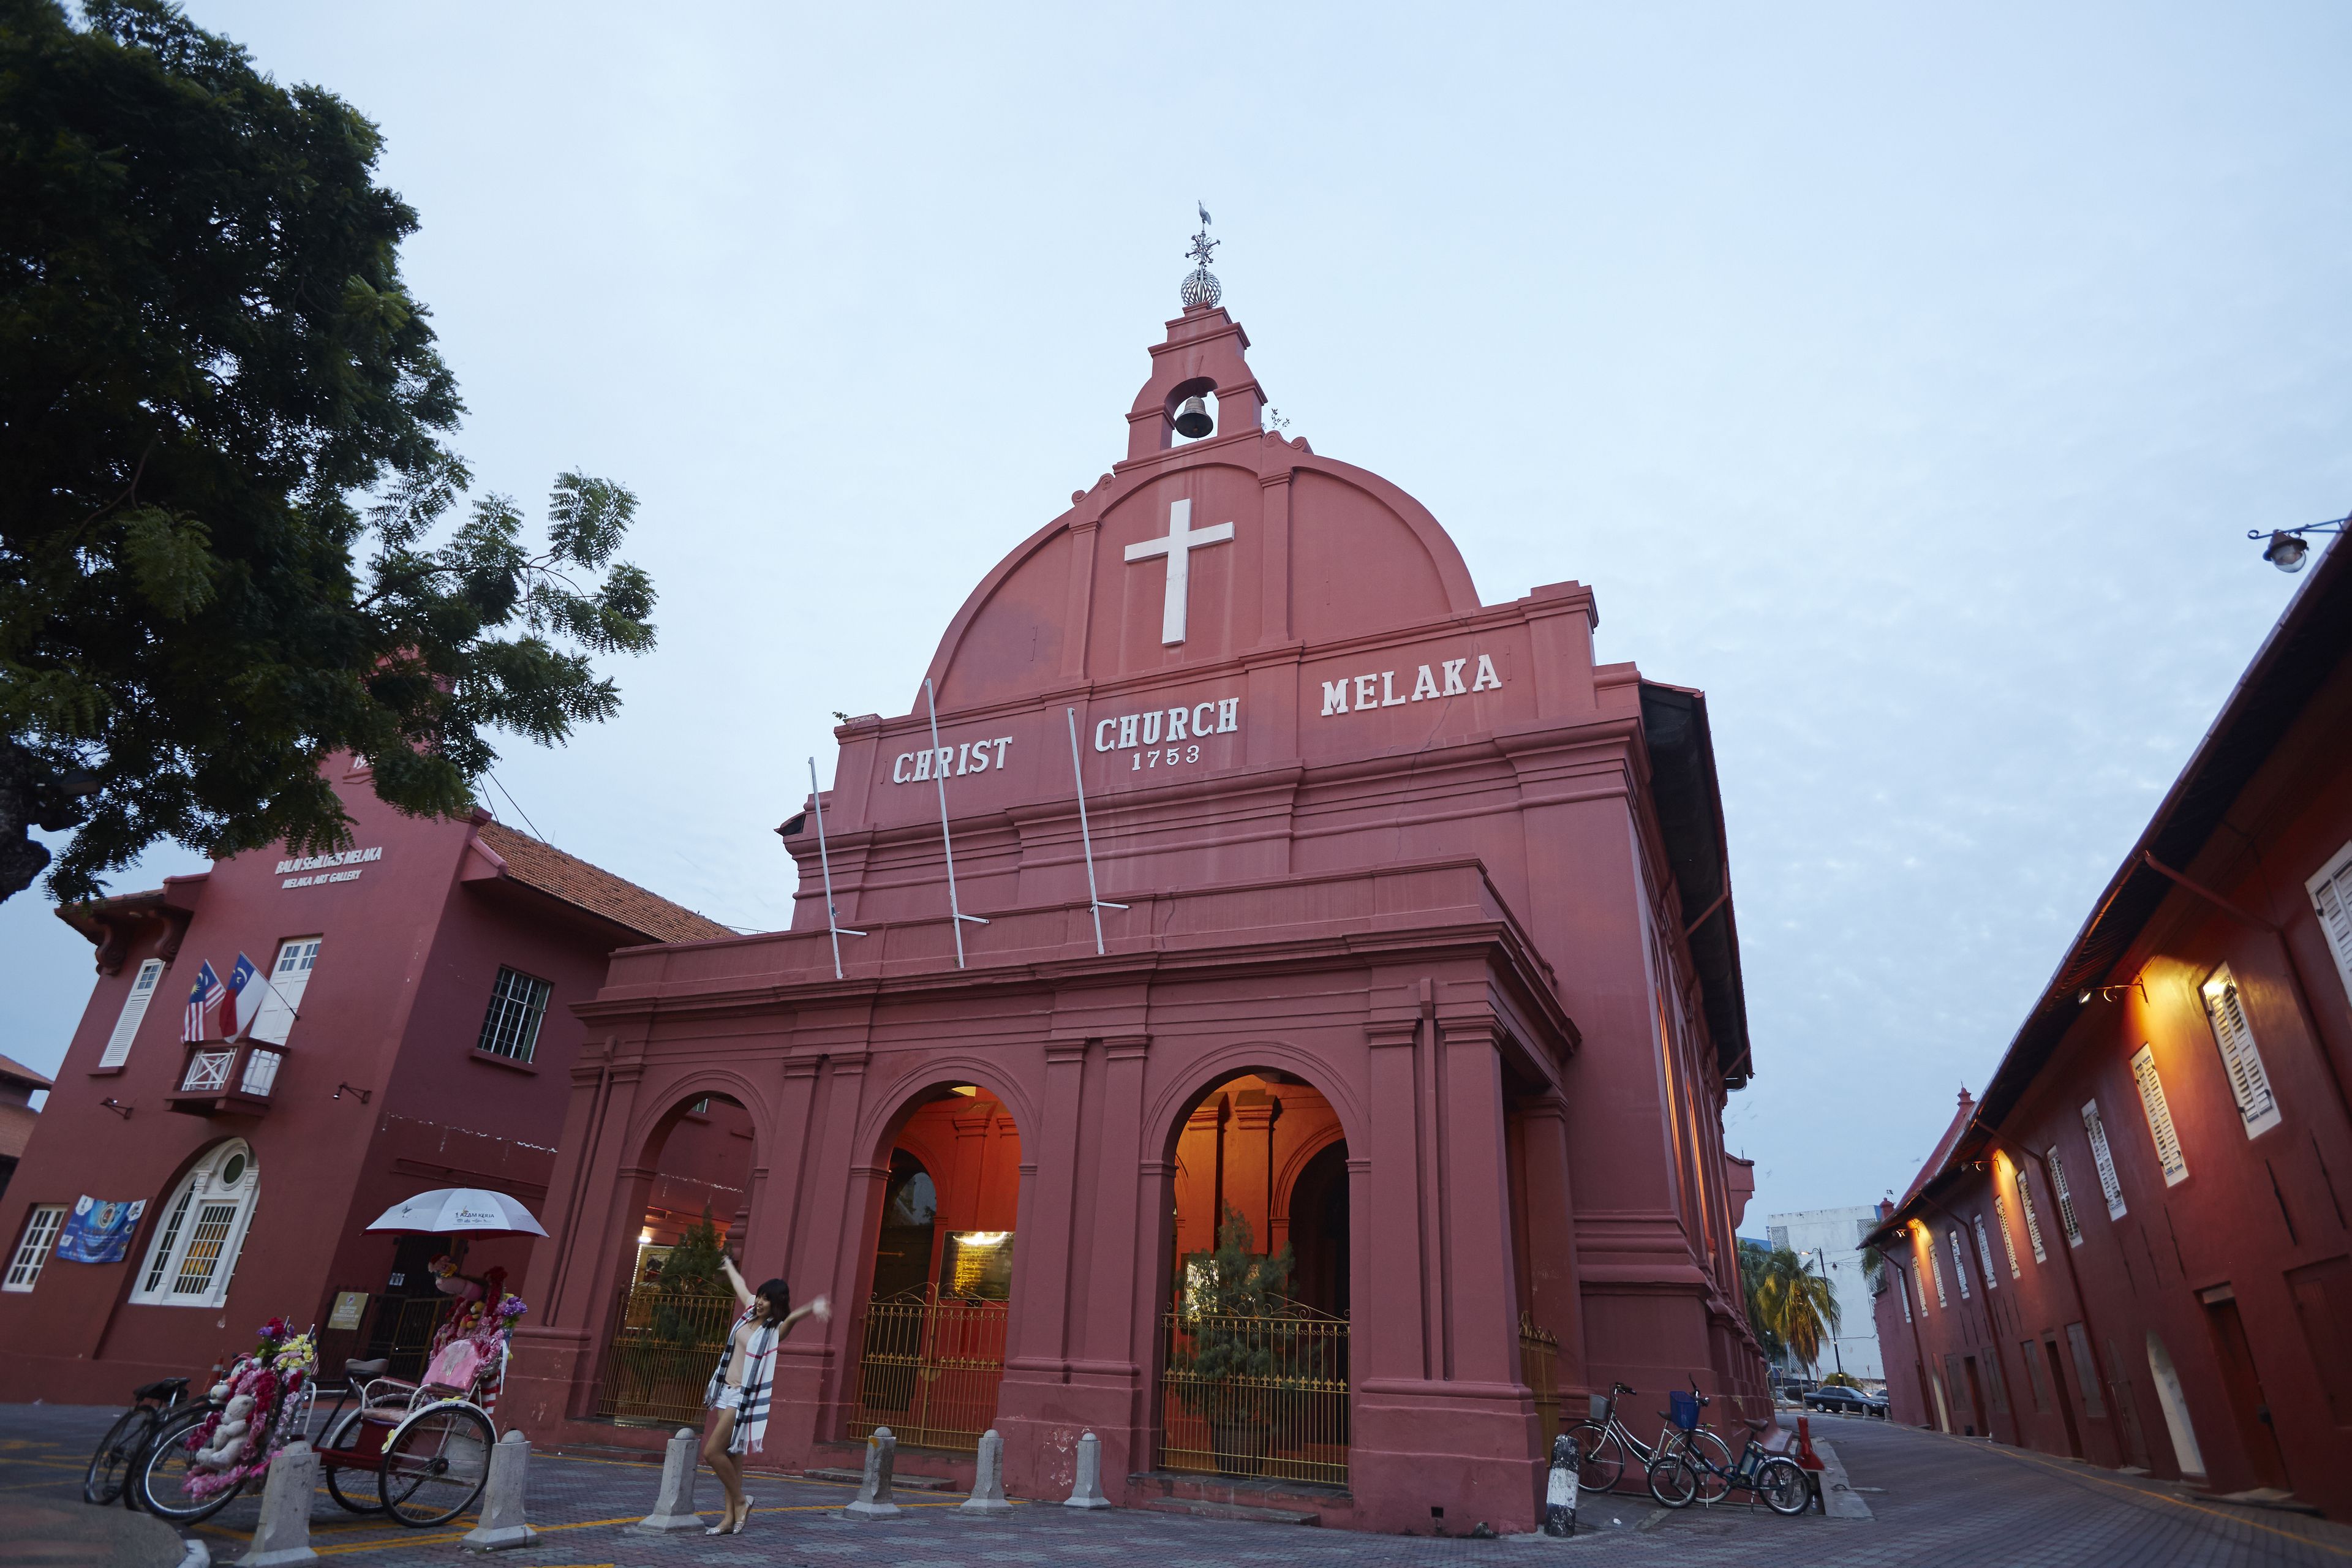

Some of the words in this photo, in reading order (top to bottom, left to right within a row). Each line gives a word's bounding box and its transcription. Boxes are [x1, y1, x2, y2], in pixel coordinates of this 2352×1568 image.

[893, 736, 1013, 784] CHRIST
[1095, 697, 1239, 753] CHURCH
[1321, 654, 1502, 717] MELAKA
[1132, 745, 1200, 771] 1753
[275, 858, 303, 875] BALAI
[343, 847, 383, 865] MELAKA
[282, 876, 313, 889] MELAKA
[313, 873, 331, 885] ART
[330, 870, 363, 883] GALLERY
